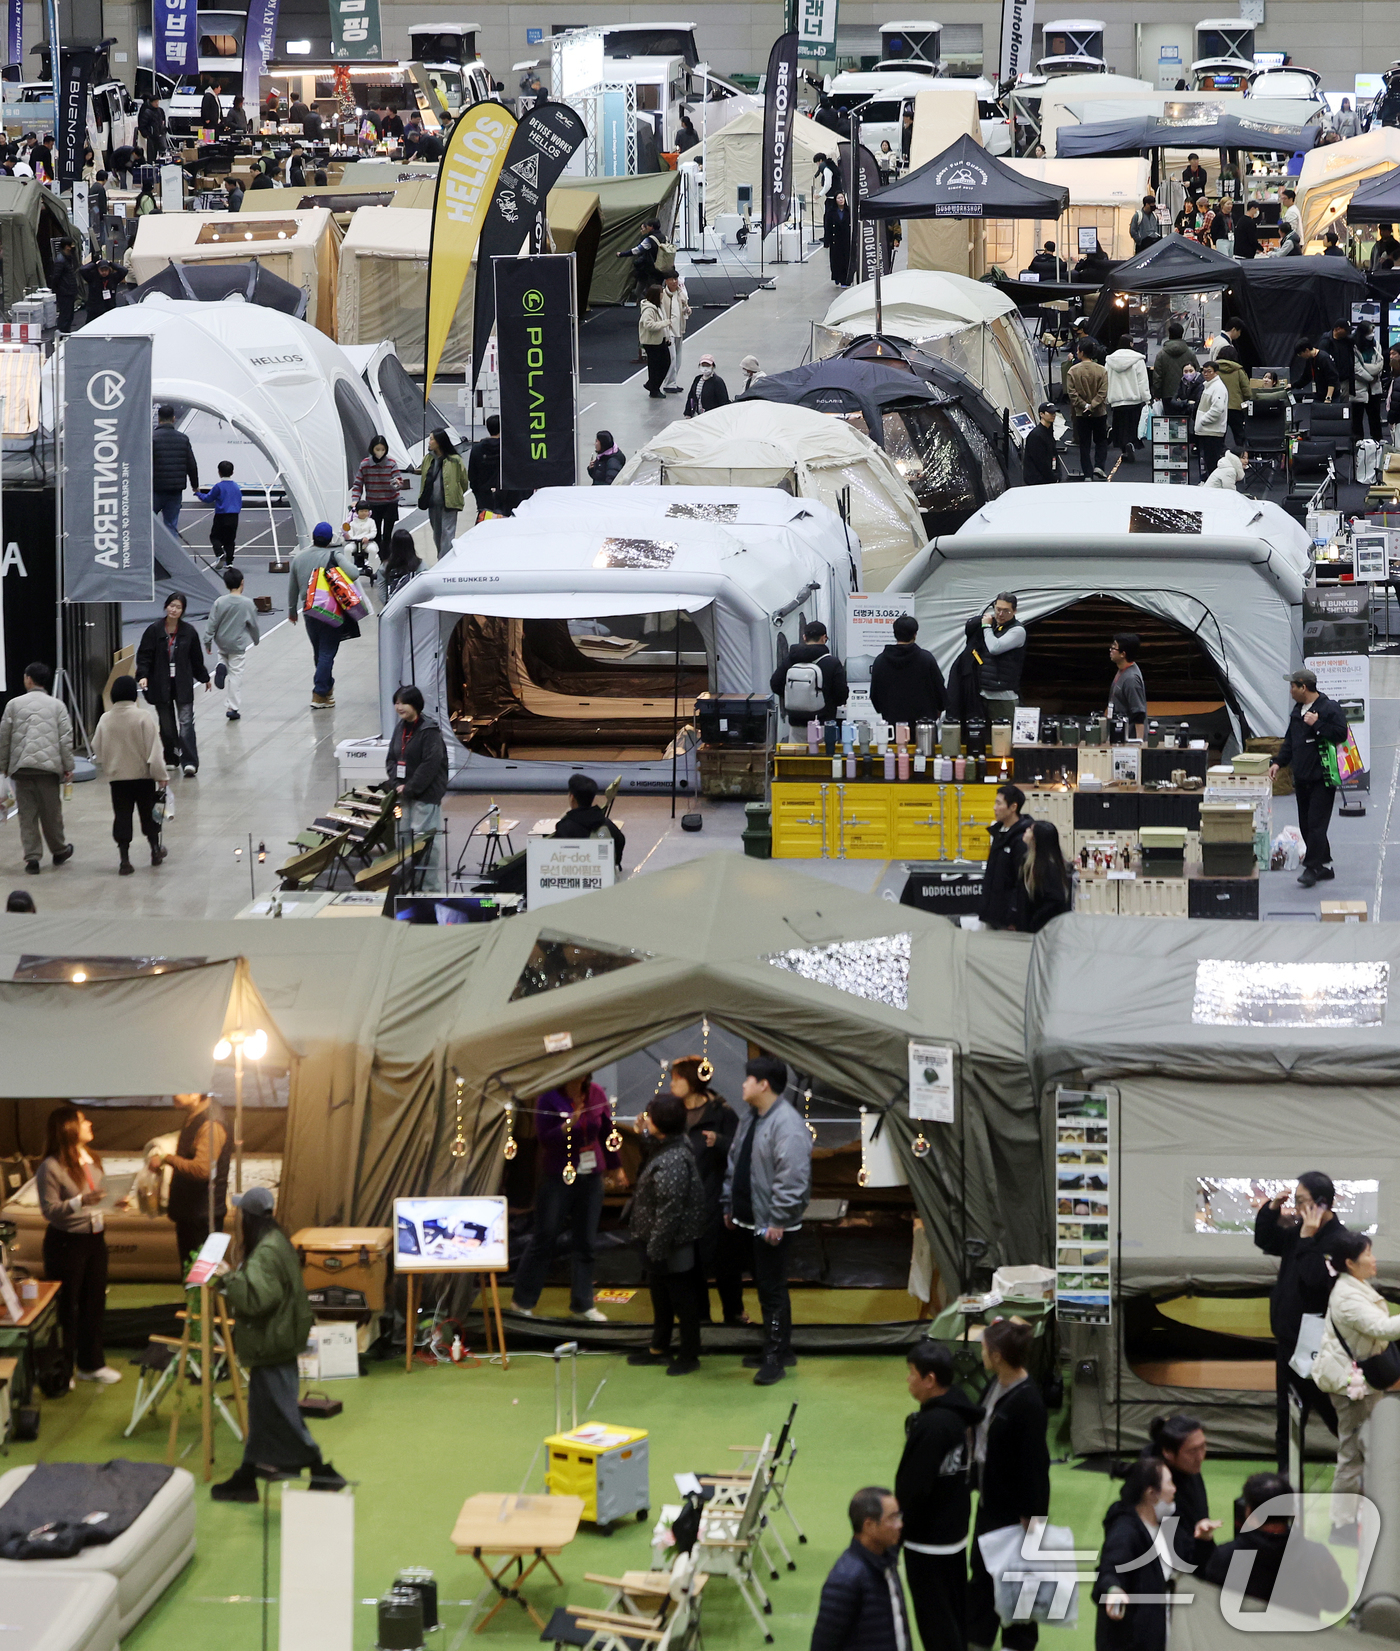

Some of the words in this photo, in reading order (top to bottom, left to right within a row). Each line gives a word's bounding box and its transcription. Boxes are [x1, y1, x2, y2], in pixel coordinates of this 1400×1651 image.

[263, 9, 274, 26] RV
[66, 80, 80, 173] BUENOFE
[529, 117, 552, 138] DEVISE
[550, 133, 572, 154] WORKS
[774, 62, 789, 194] RECOLLECTOR
[529, 130, 560, 158] HELLOS
[446, 116, 504, 224] HELLOS
[250, 354, 304, 366] HELLOS
[526, 327, 548, 460] POLARIS
[540, 865, 560, 875] 무선
[562, 865, 601, 876] 에어펌프
[550, 852, 591, 863] Air-dot
[540, 878, 580, 888] 예약판매
[582, 878, 602, 889] 할인
